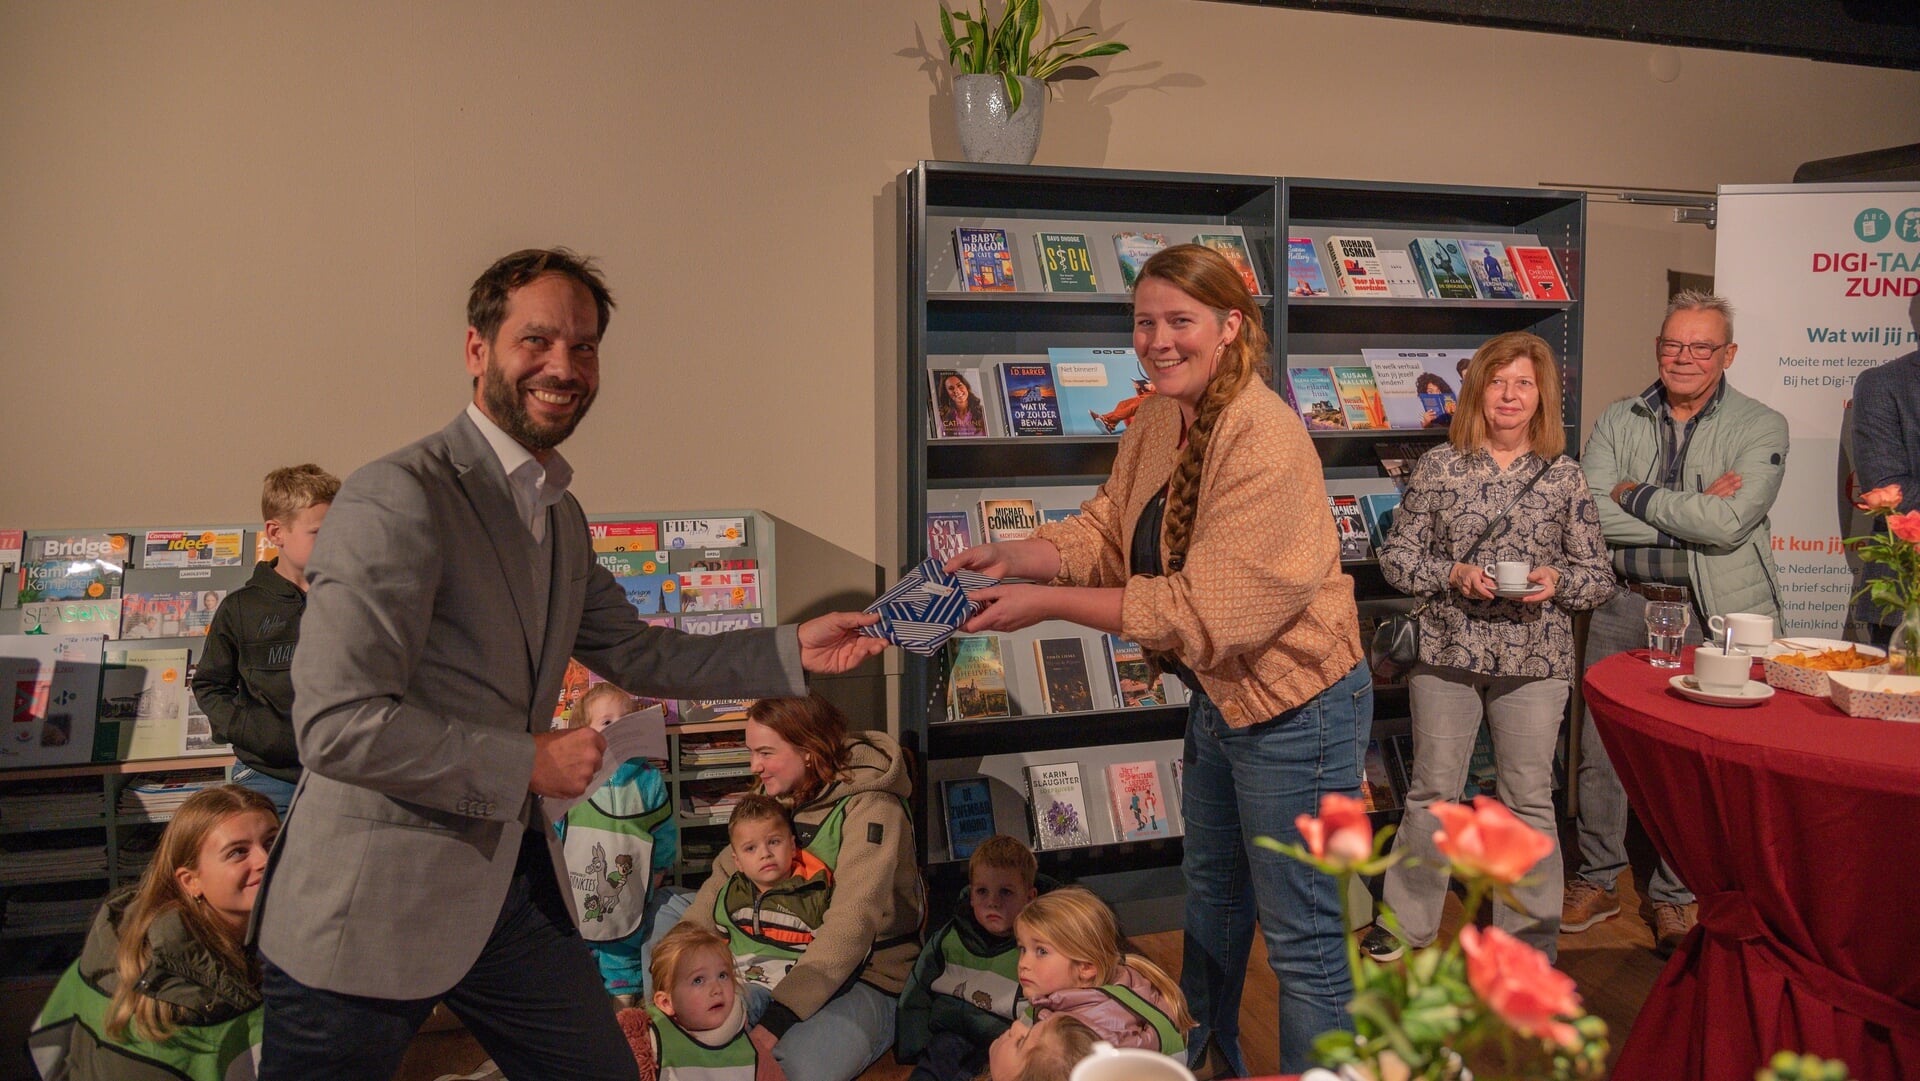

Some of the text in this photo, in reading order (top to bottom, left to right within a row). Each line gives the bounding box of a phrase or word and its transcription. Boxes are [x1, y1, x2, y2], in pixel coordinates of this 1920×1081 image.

[971, 233, 996, 243] BABY
[964, 242, 1005, 253] DRAGON
[1343, 248, 1377, 259] OSMAN
[1807, 327, 1848, 343] Wat
[1851, 327, 1879, 343] wil
[1882, 327, 1902, 346] jij
[1778, 357, 1820, 367] Moeite
[1822, 357, 1844, 367] met
[1847, 356, 1880, 368] lezen,
[1023, 369, 1047, 377] BARKER
[1783, 375, 1798, 387] Bij
[1800, 375, 1820, 386] het
[1020, 403, 1048, 411] WAT IK
[1027, 411, 1057, 419] ZOLDER
[1020, 419, 1054, 428] BEWAAR
[995, 507, 1026, 517] MICHAEL
[665, 521, 709, 533] FIETS
[932, 519, 960, 536] ST
[988, 515, 1035, 530] CONNELLY
[149, 533, 183, 541] Computer
[45, 538, 112, 559] Bridge
[168, 536, 207, 551] idee
[1771, 536, 1785, 551] it
[1789, 536, 1824, 551] kun
[1788, 564, 1860, 574] Nederlandse
[1792, 583, 1819, 593] brief
[1808, 601, 1846, 613] helpen
[24, 605, 120, 625] SEASONS
[687, 620, 749, 635] YOUTH
[1043, 771, 1067, 780] KARIN
[1033, 776, 1080, 788] SLAUGHTER
